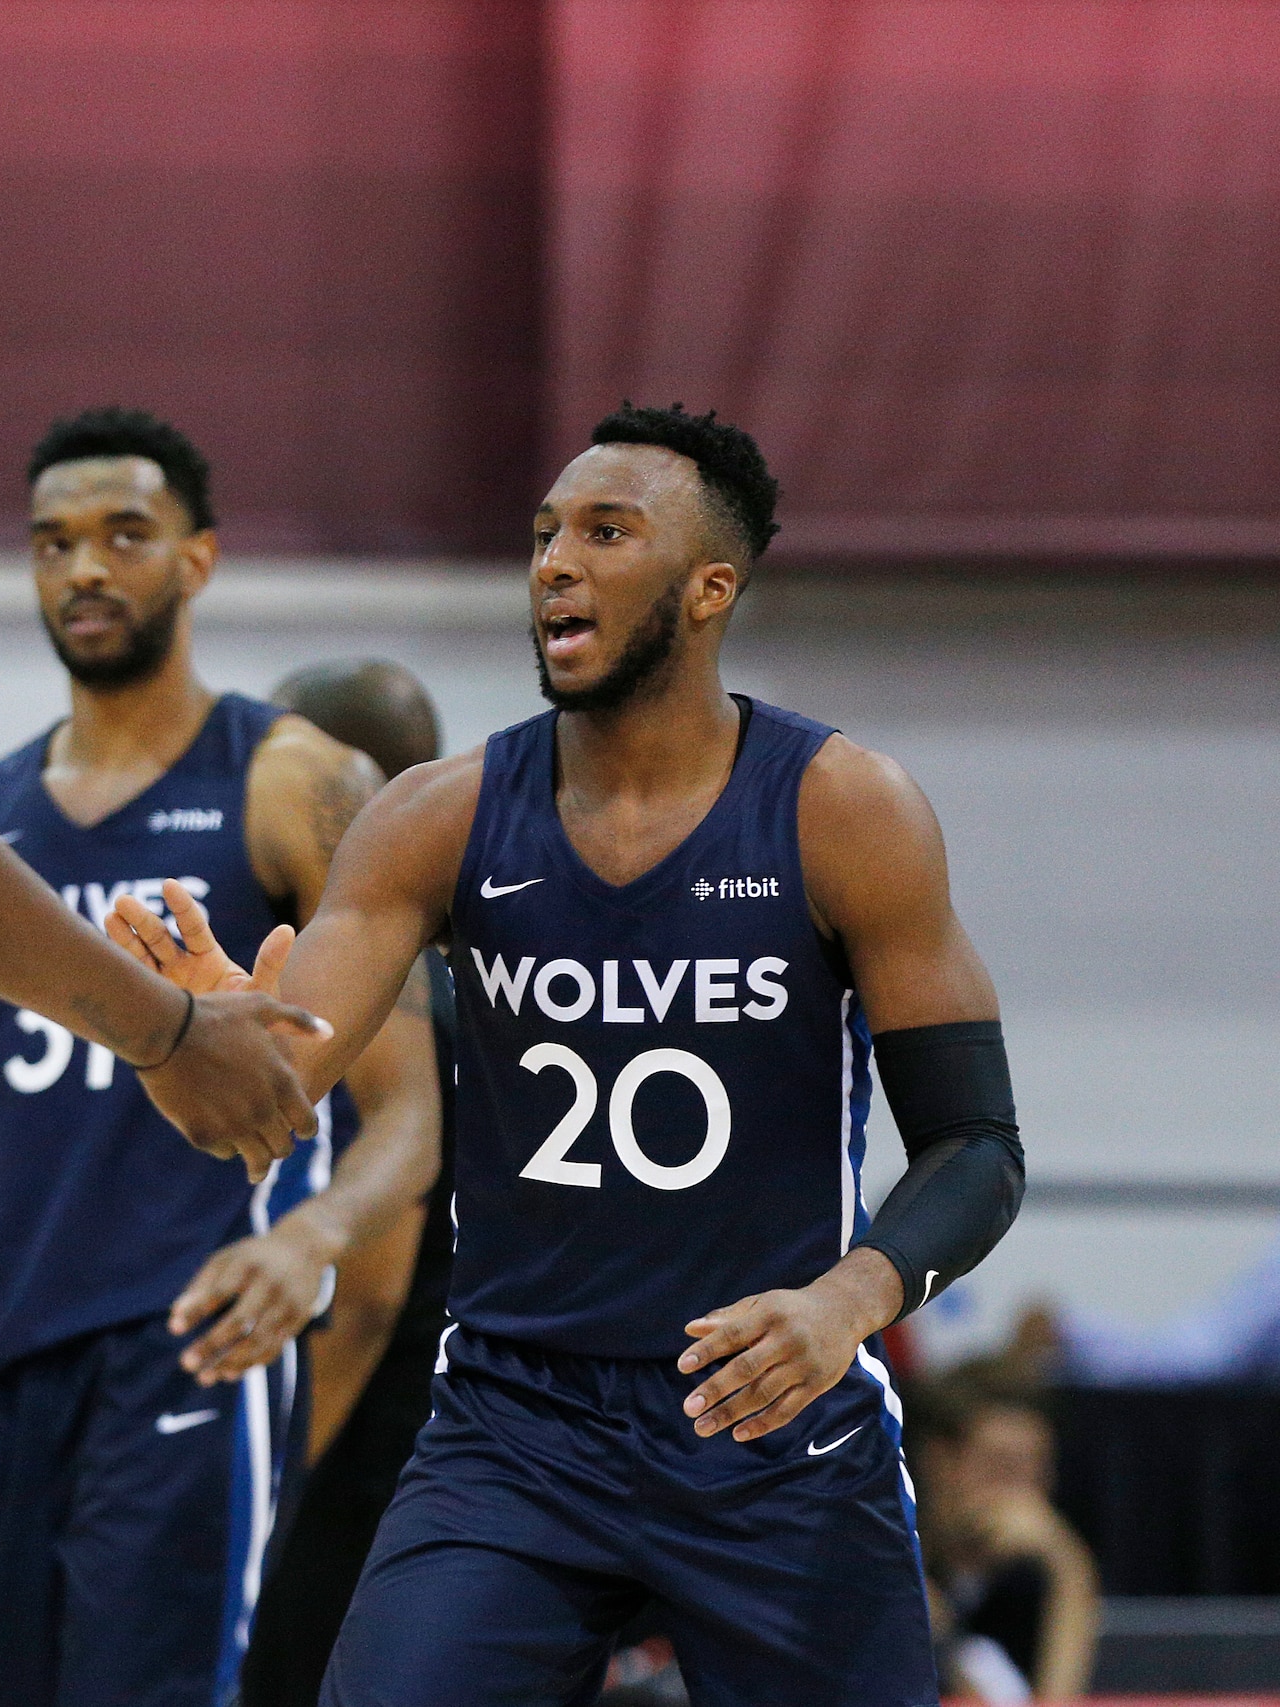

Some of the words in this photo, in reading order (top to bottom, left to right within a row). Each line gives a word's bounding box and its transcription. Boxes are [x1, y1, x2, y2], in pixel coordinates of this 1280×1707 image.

[718, 876, 780, 900] fitbit
[470, 946, 791, 1024] WOLVES
[518, 1042, 732, 1191] 20
